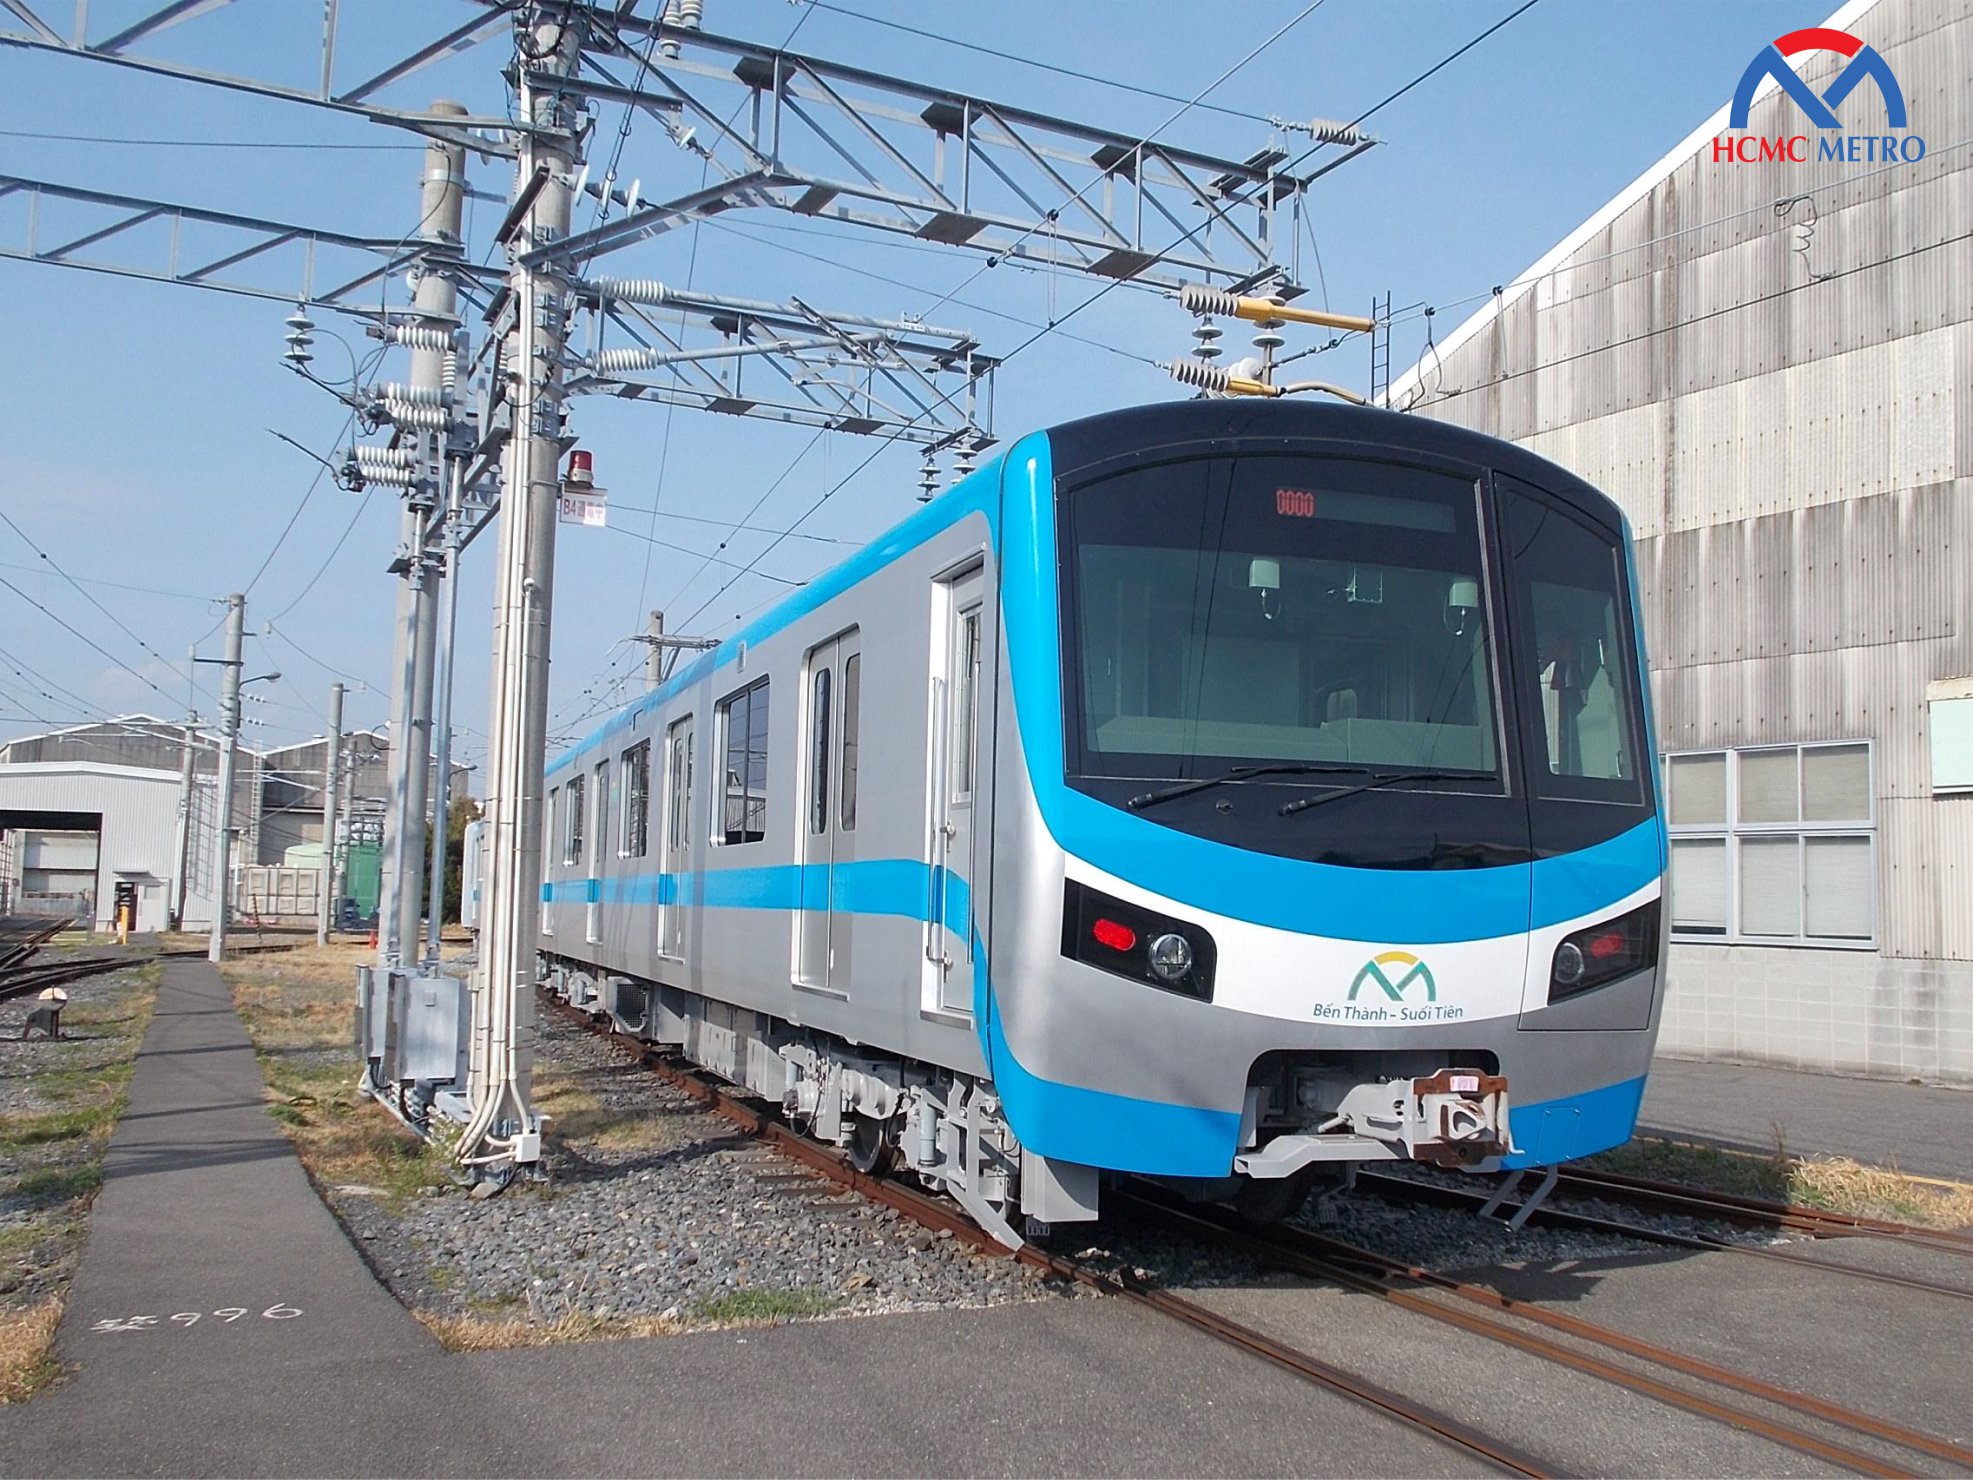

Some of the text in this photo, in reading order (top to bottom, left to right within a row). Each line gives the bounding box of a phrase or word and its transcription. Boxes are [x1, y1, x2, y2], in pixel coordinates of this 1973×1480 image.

[1313, 1003, 1341, 1018] Bến
[1344, 1006, 1388, 1020] Thành
[1400, 1005, 1432, 1020] Suối
[1435, 1005, 1463, 1019] Tiên
